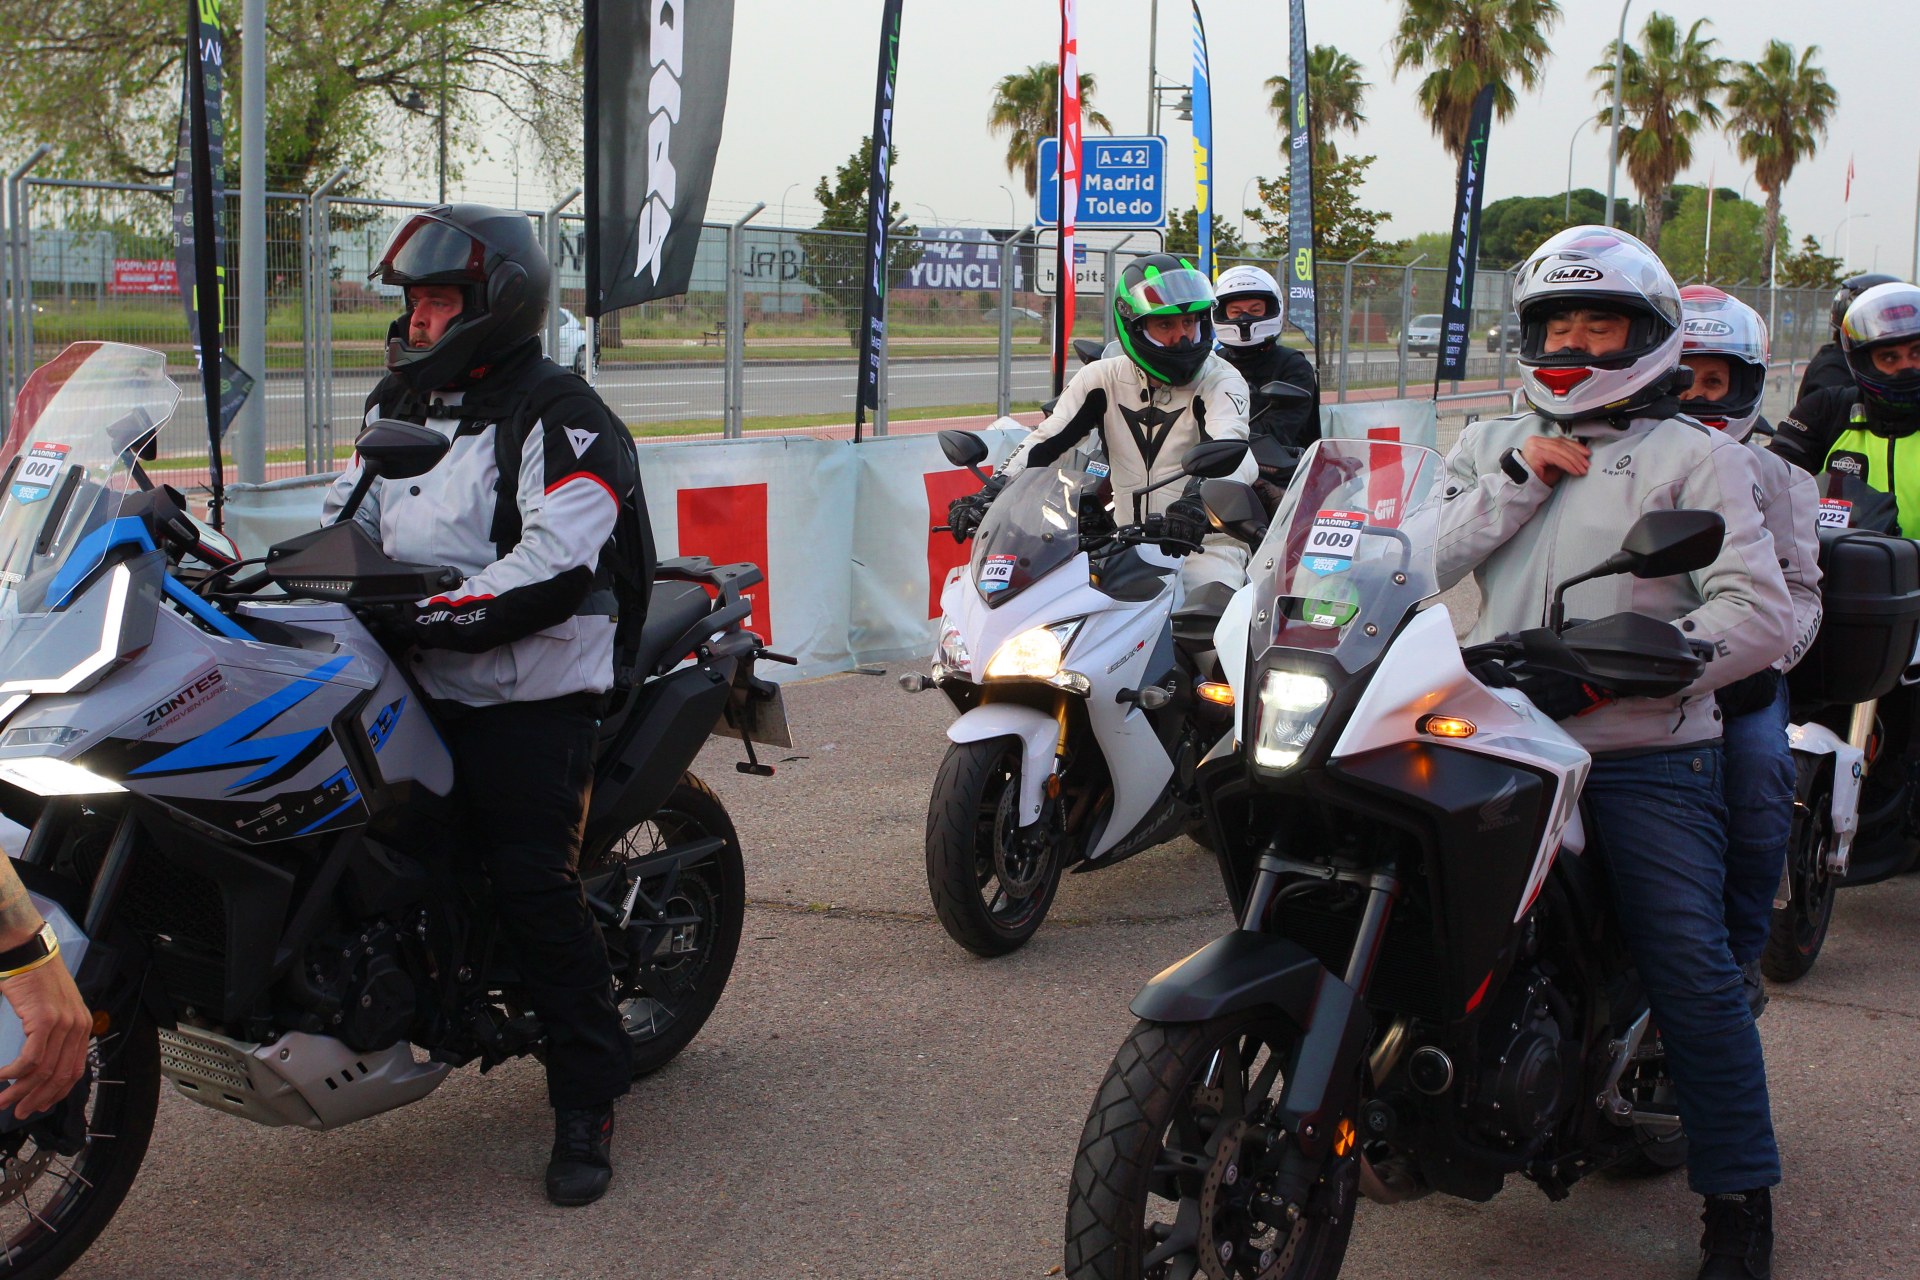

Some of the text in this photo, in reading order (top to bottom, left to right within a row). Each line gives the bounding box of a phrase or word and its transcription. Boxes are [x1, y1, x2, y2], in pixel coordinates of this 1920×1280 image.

[1100, 150, 1146, 165] A-42
[1085, 174, 1154, 191] Madrid
[1085, 197, 1153, 215] Toledo
[1450, 156, 1475, 310] FULBAT
[1549, 269, 1597, 281] HJC
[1684, 322, 1728, 333] HJC
[25, 461, 56, 478] 001
[1602, 468, 1636, 479] ARMURE
[1317, 518, 1351, 528] MADRID
[1820, 511, 1846, 524] 022
[1313, 531, 1354, 548] 009
[1312, 563, 1335, 572] SOUL
[1313, 558, 1339, 567] RIDER
[986, 566, 1008, 576] 016
[416, 607, 487, 625] DAINESE
[1784, 609, 1822, 665] ARMURE
[143, 669, 223, 727] ZONTES
